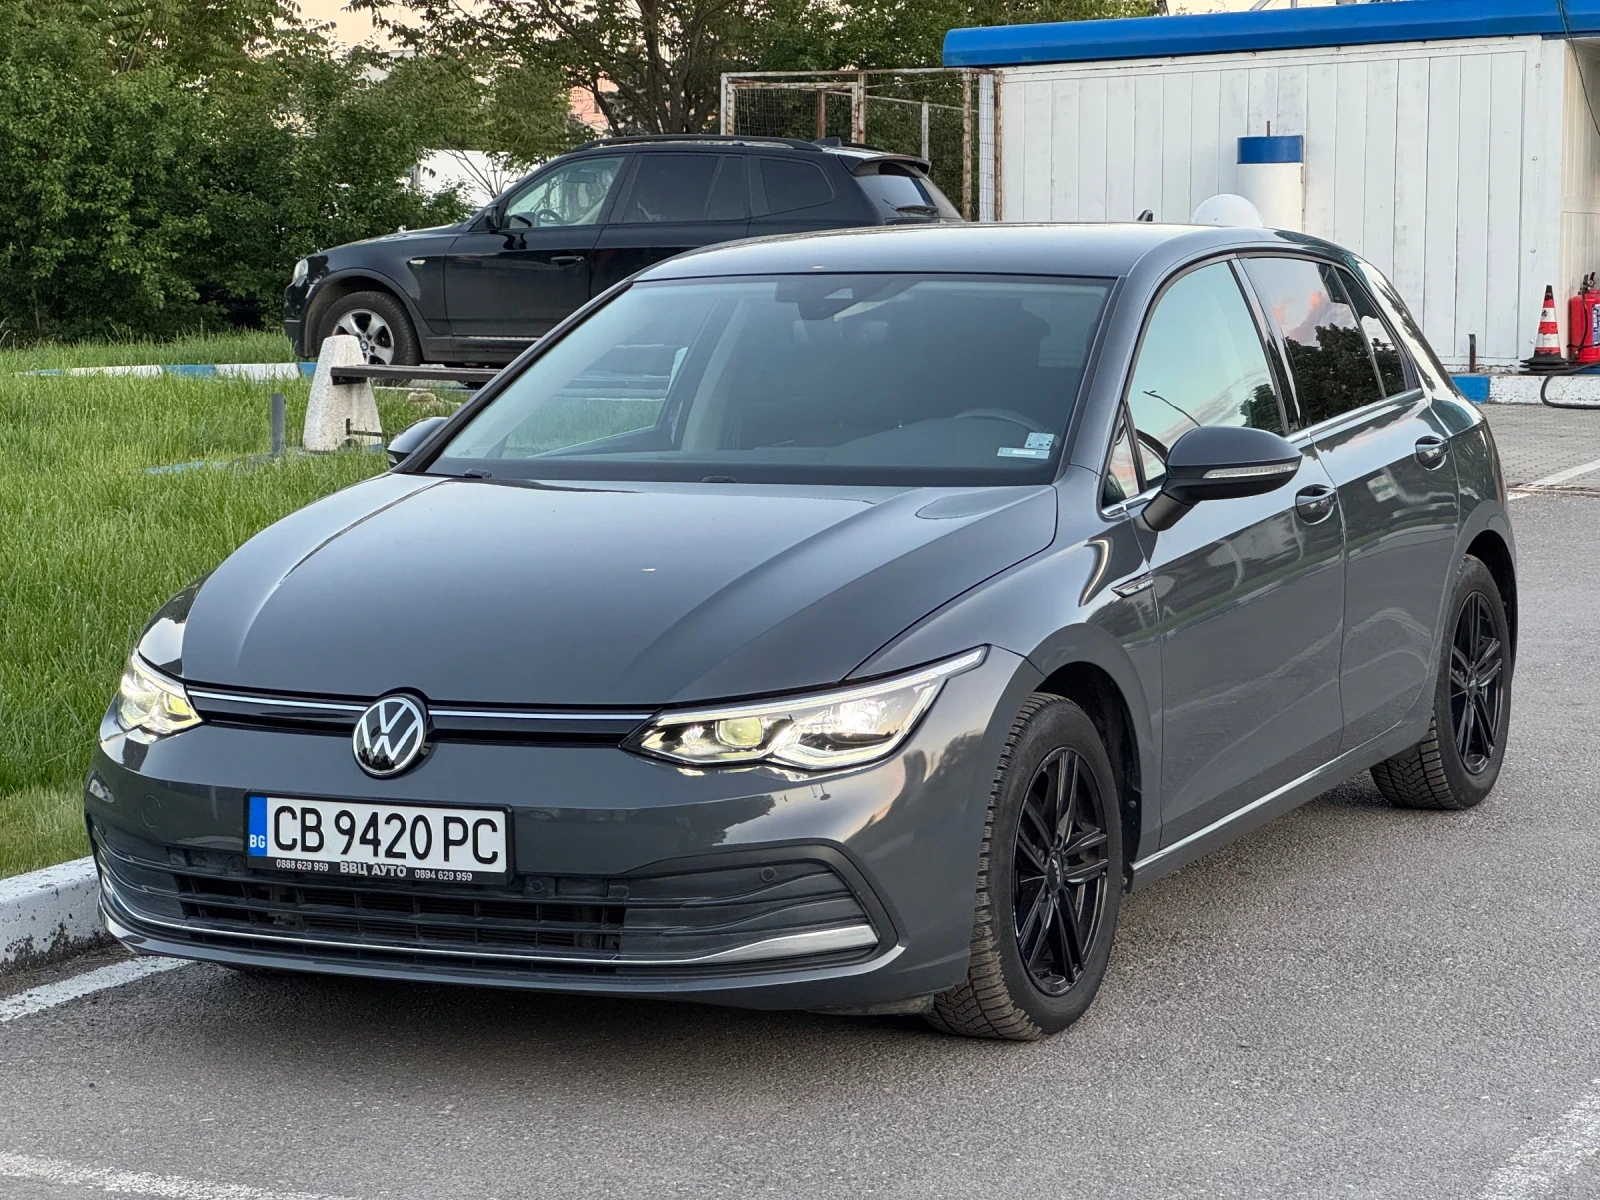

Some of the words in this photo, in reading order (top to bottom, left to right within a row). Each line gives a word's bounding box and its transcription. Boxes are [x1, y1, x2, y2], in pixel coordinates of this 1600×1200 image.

[357, 699, 420, 770] VW
[249, 834, 266, 849] BG
[273, 805, 325, 853] CB
[334, 809, 433, 861] 9420
[443, 815, 499, 865] PC
[275, 859, 296, 869] 0888
[297, 860, 312, 871] 629
[313, 862, 329, 872] 959
[340, 860, 368, 877] ВВЦ
[371, 863, 407, 877] АУТО
[414, 869, 436, 879] 0894
[437, 870, 454, 881] 629
[456, 871, 473, 882] 959
